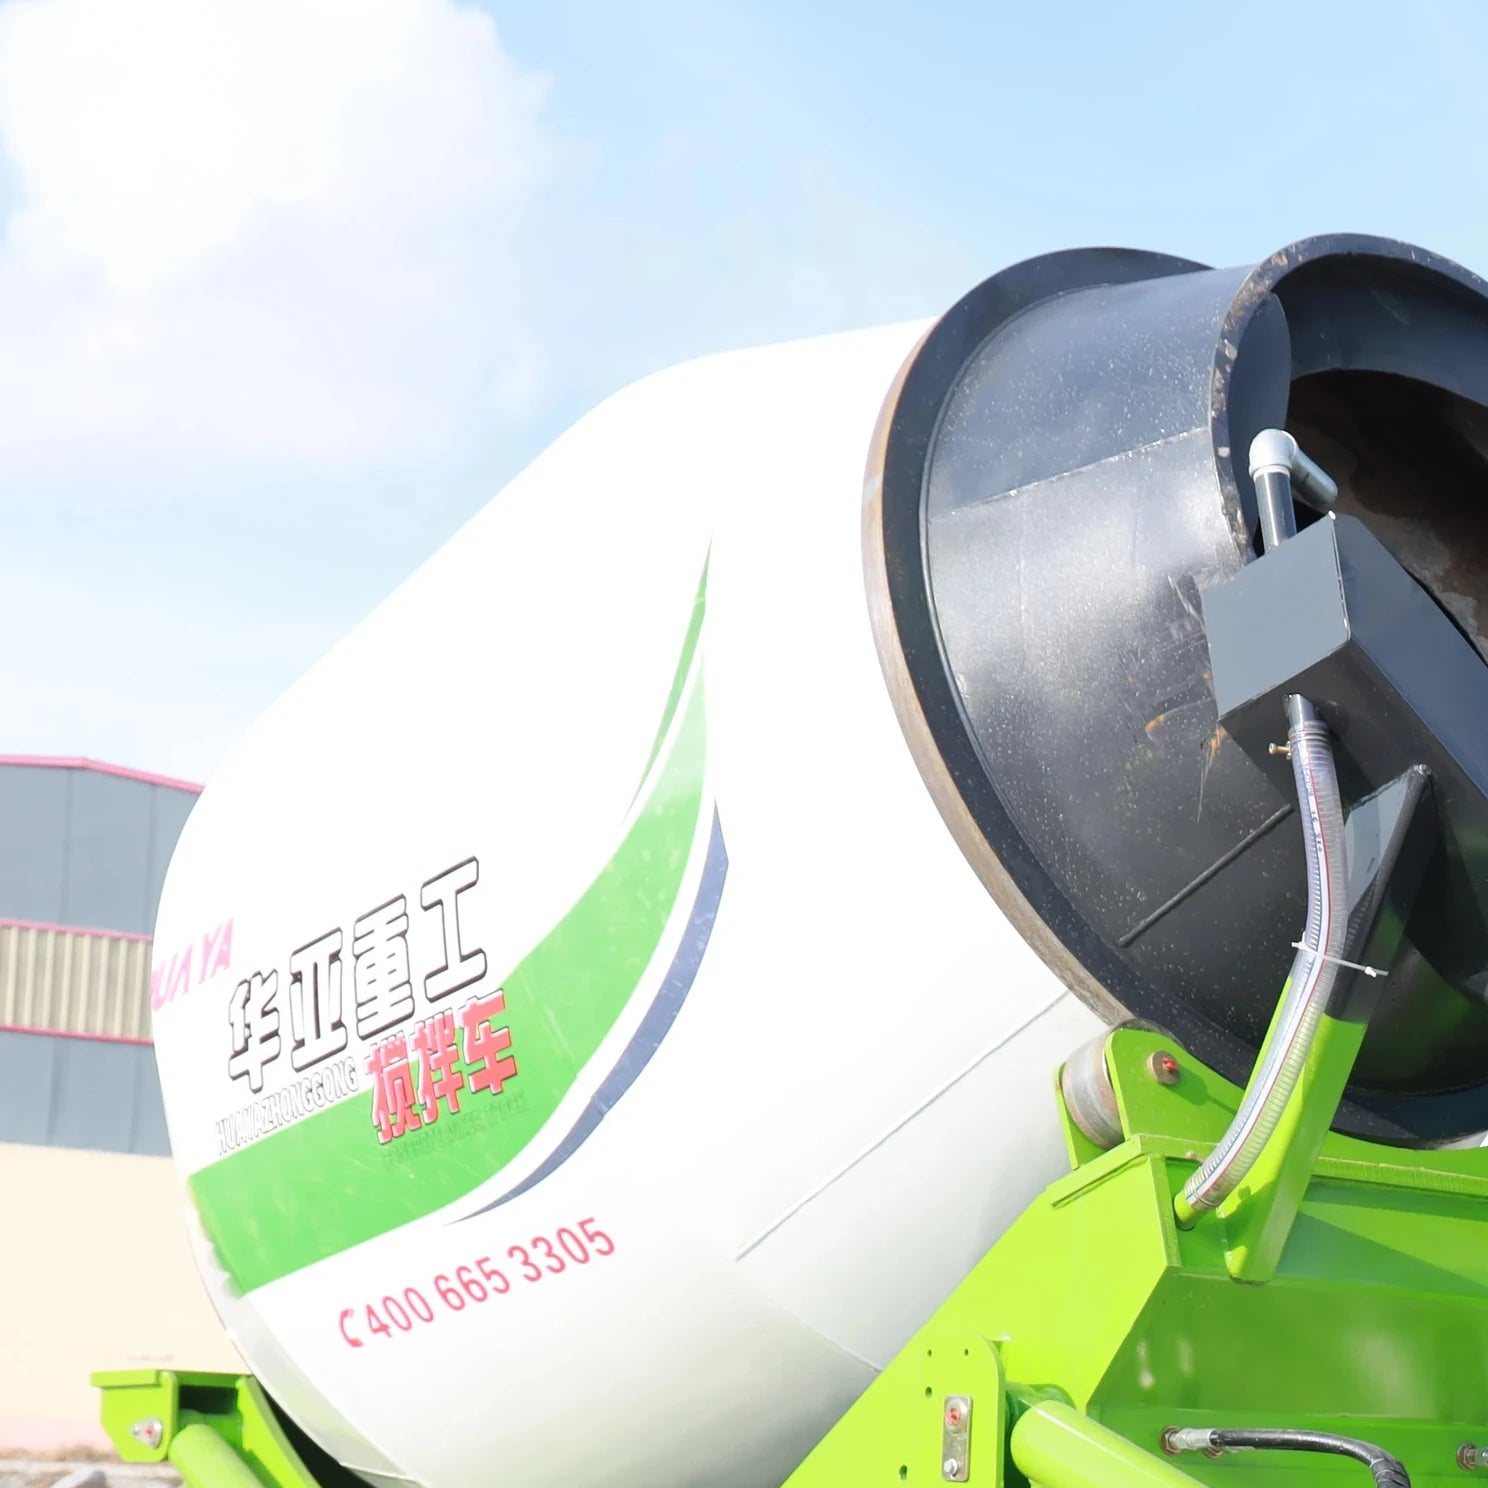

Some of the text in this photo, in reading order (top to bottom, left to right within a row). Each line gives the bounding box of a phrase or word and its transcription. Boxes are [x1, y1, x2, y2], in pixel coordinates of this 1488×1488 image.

[229, 855, 488, 1094] 华亚重工
[364, 988, 518, 1145] 搅拌车
[365, 1216, 616, 1338] 400 665 3305
